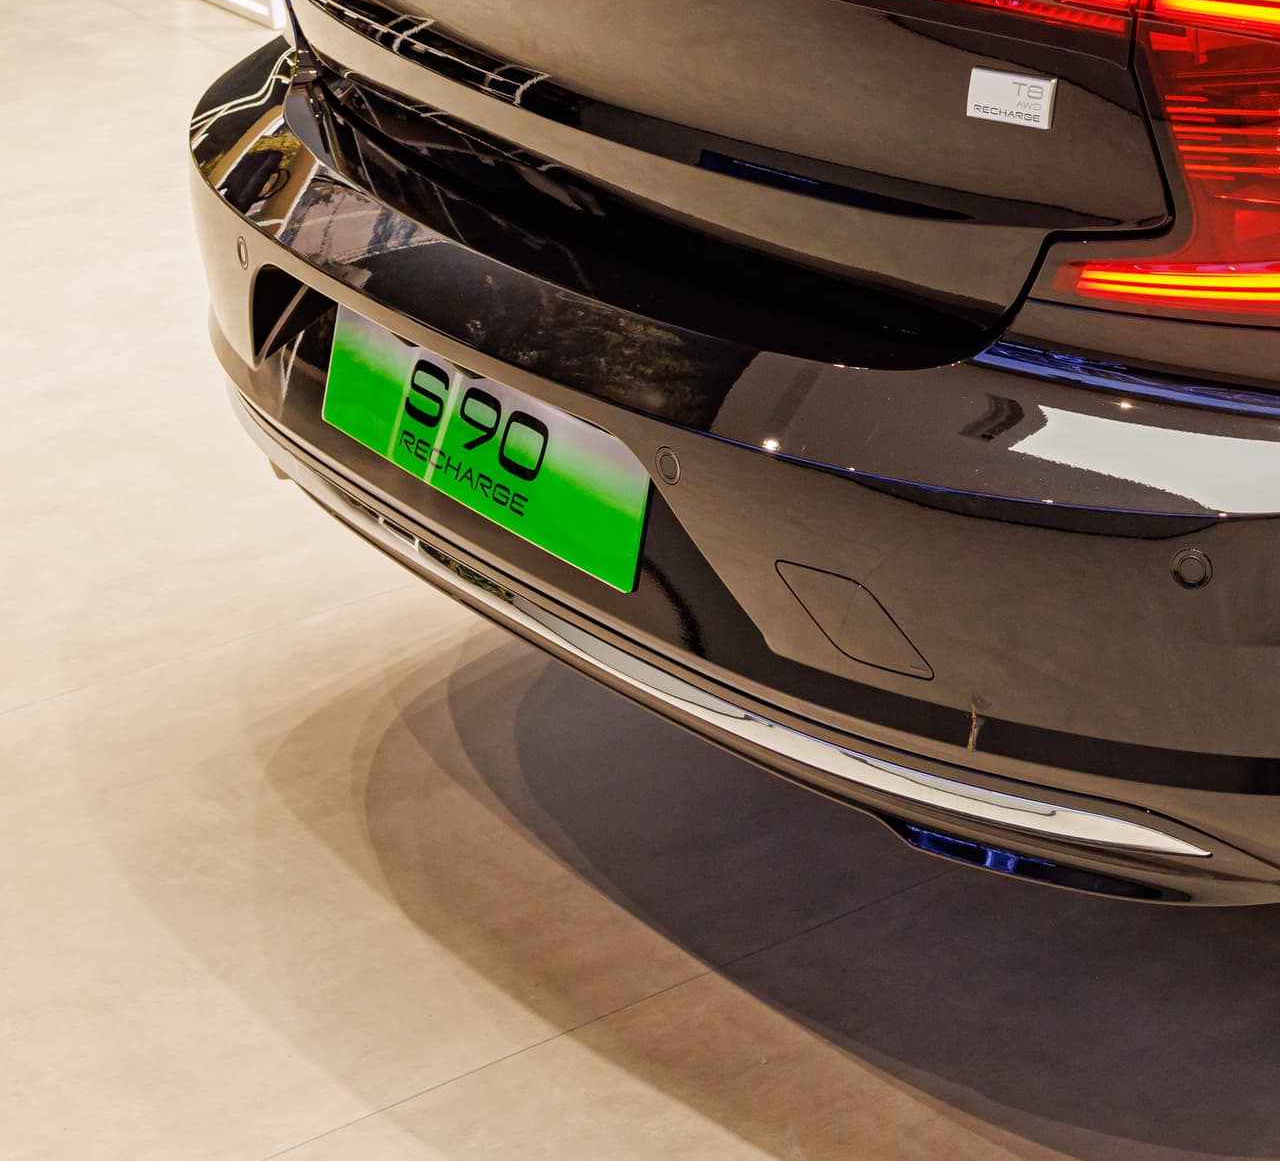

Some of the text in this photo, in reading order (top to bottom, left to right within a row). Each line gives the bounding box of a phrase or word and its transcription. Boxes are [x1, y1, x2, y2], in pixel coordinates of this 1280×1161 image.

[1012, 81, 1044, 100] T8
[973, 103, 1041, 123] RECHARGE
[1015, 100, 1042, 111] AWD
[398, 429, 529, 517] RECHARGE
